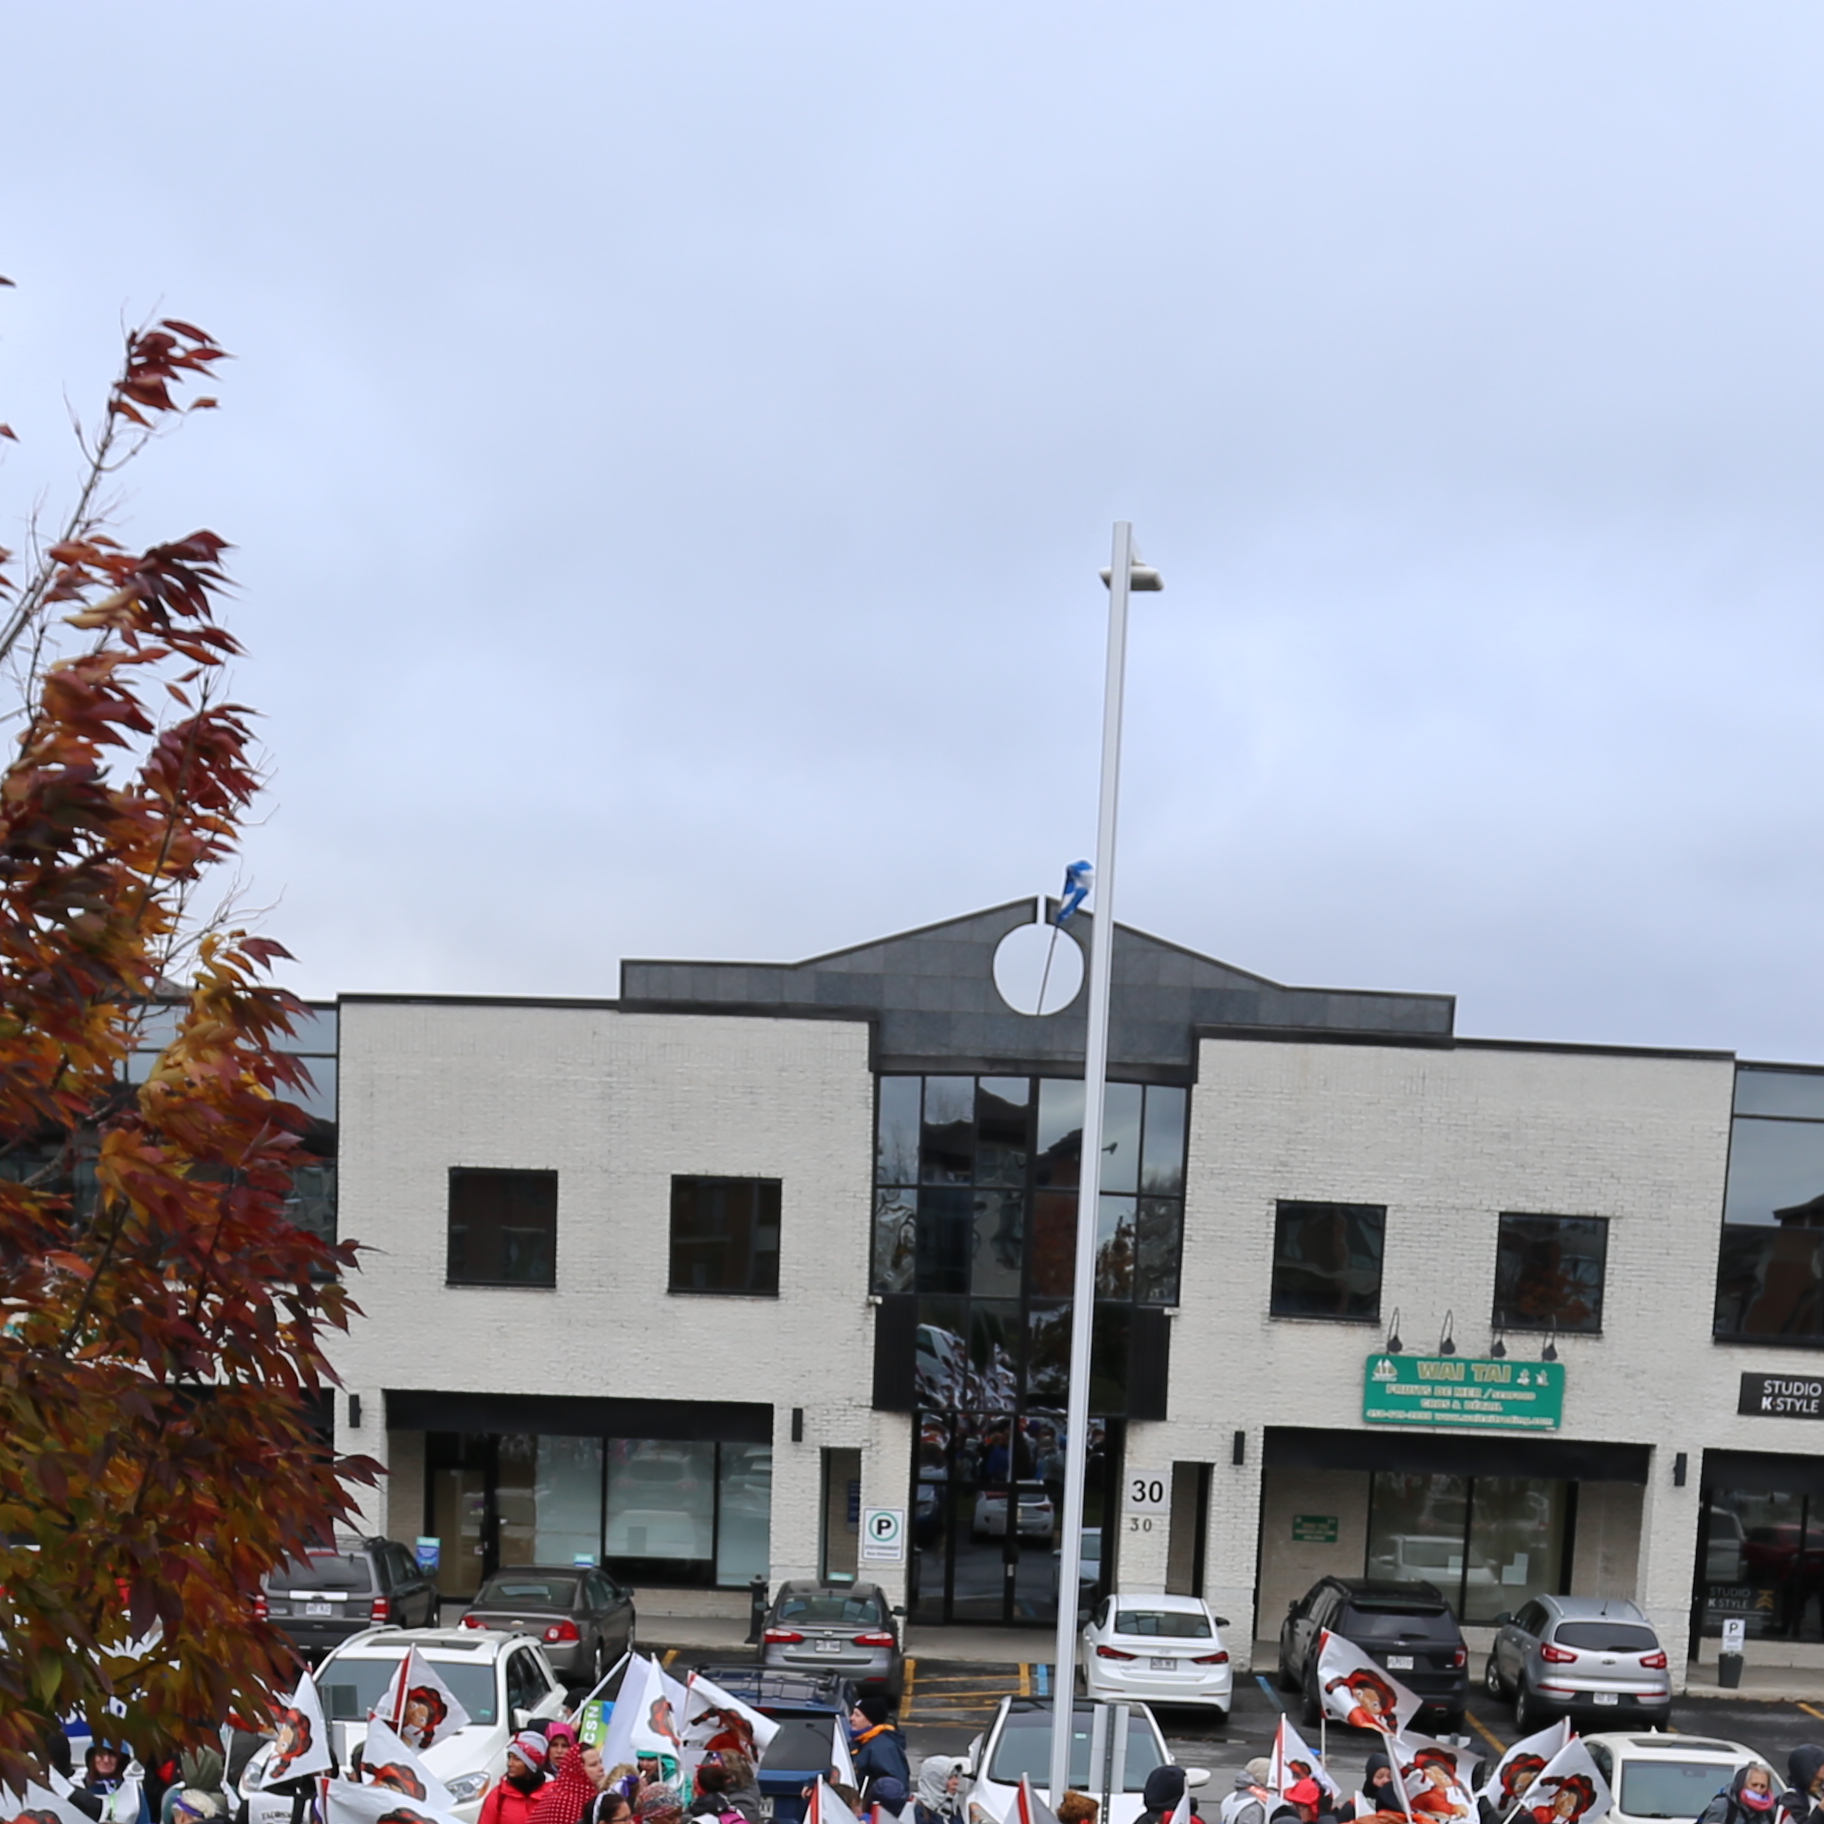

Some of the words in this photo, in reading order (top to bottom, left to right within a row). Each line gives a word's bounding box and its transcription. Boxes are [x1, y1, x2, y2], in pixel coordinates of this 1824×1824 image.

[1417, 1361, 1465, 1381] WAI
[1471, 1363, 1512, 1383] TAI
[1763, 1380, 1822, 1397] STUDIO
[1131, 1480, 1164, 1504] 30
[876, 1519, 892, 1535] P
[583, 1705, 600, 1743] CSN
